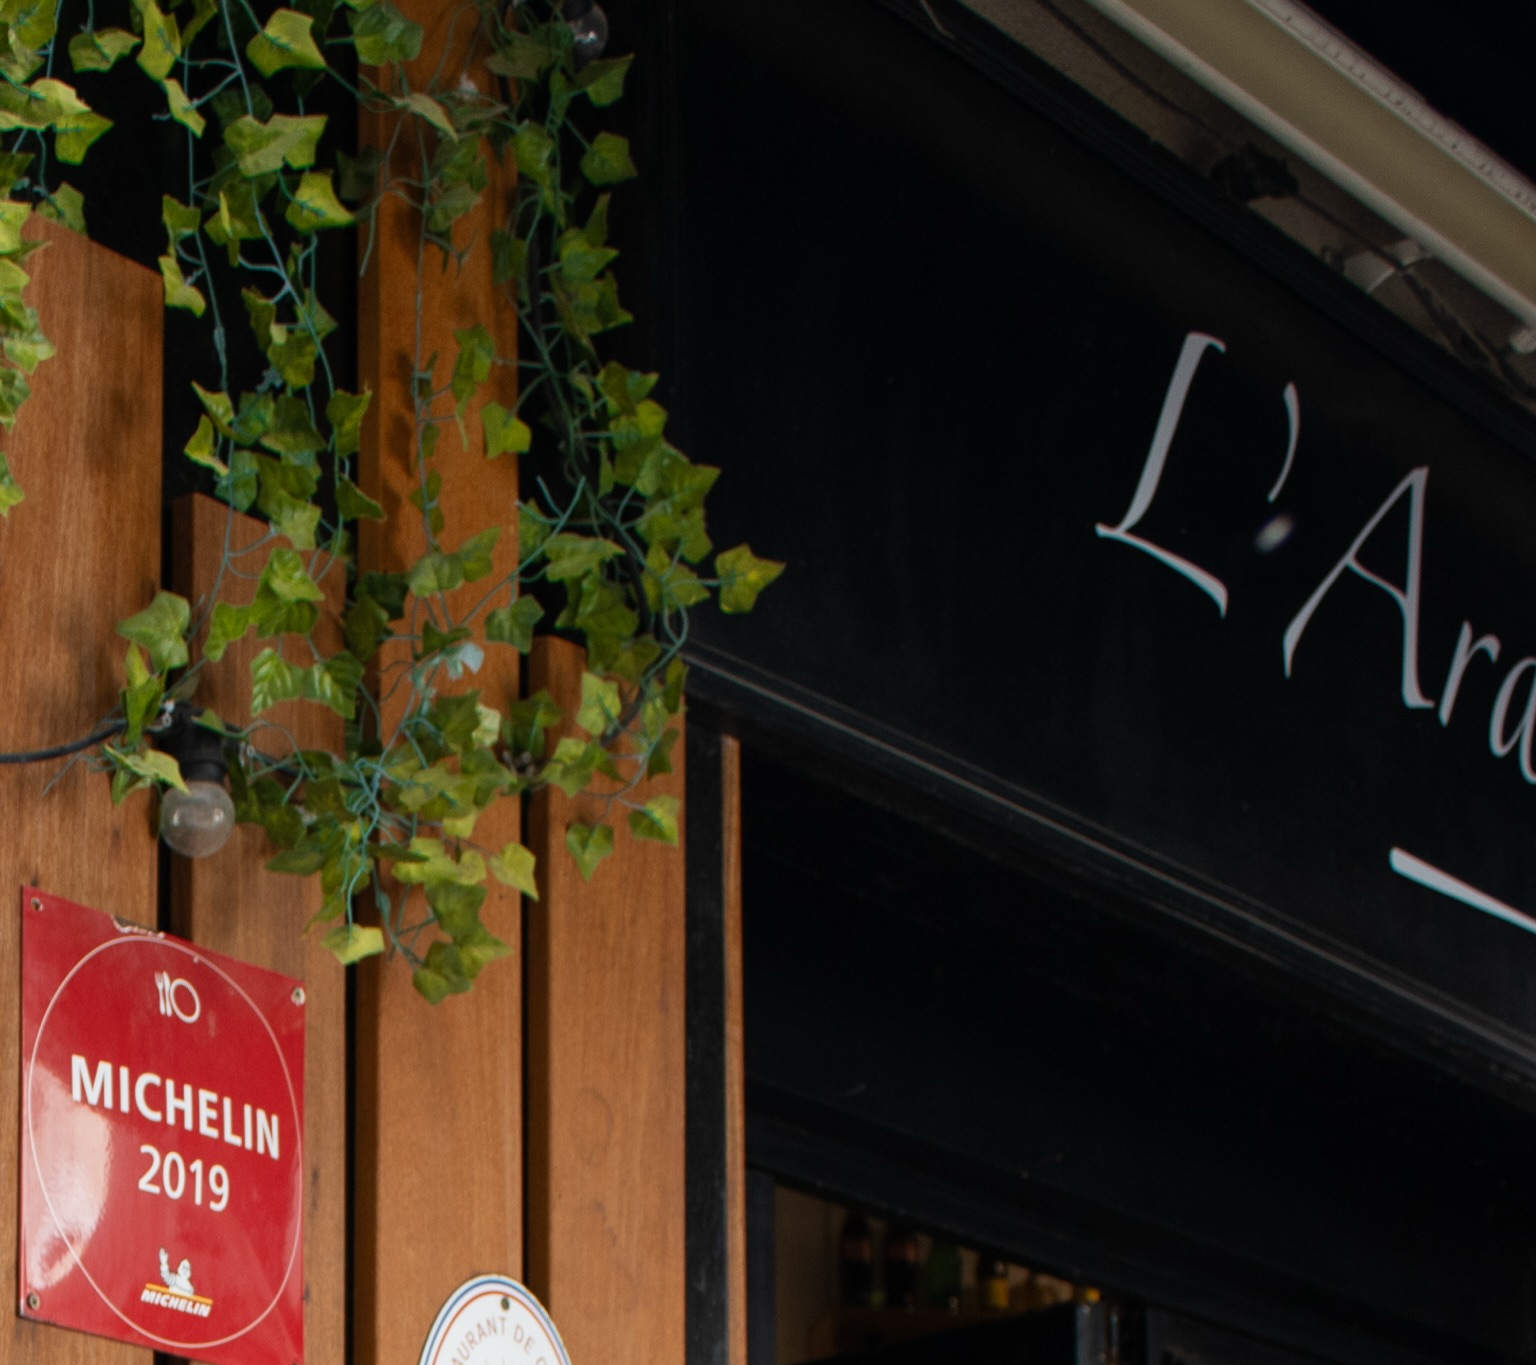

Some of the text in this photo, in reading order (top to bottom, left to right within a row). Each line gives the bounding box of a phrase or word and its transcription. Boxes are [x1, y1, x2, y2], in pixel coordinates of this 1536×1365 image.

[70, 1054, 280, 1160] MICHELIN
[138, 1144, 230, 1212] 2019
[140, 1289, 212, 1318] MICHELIN
[513, 1323, 535, 1355] DE
